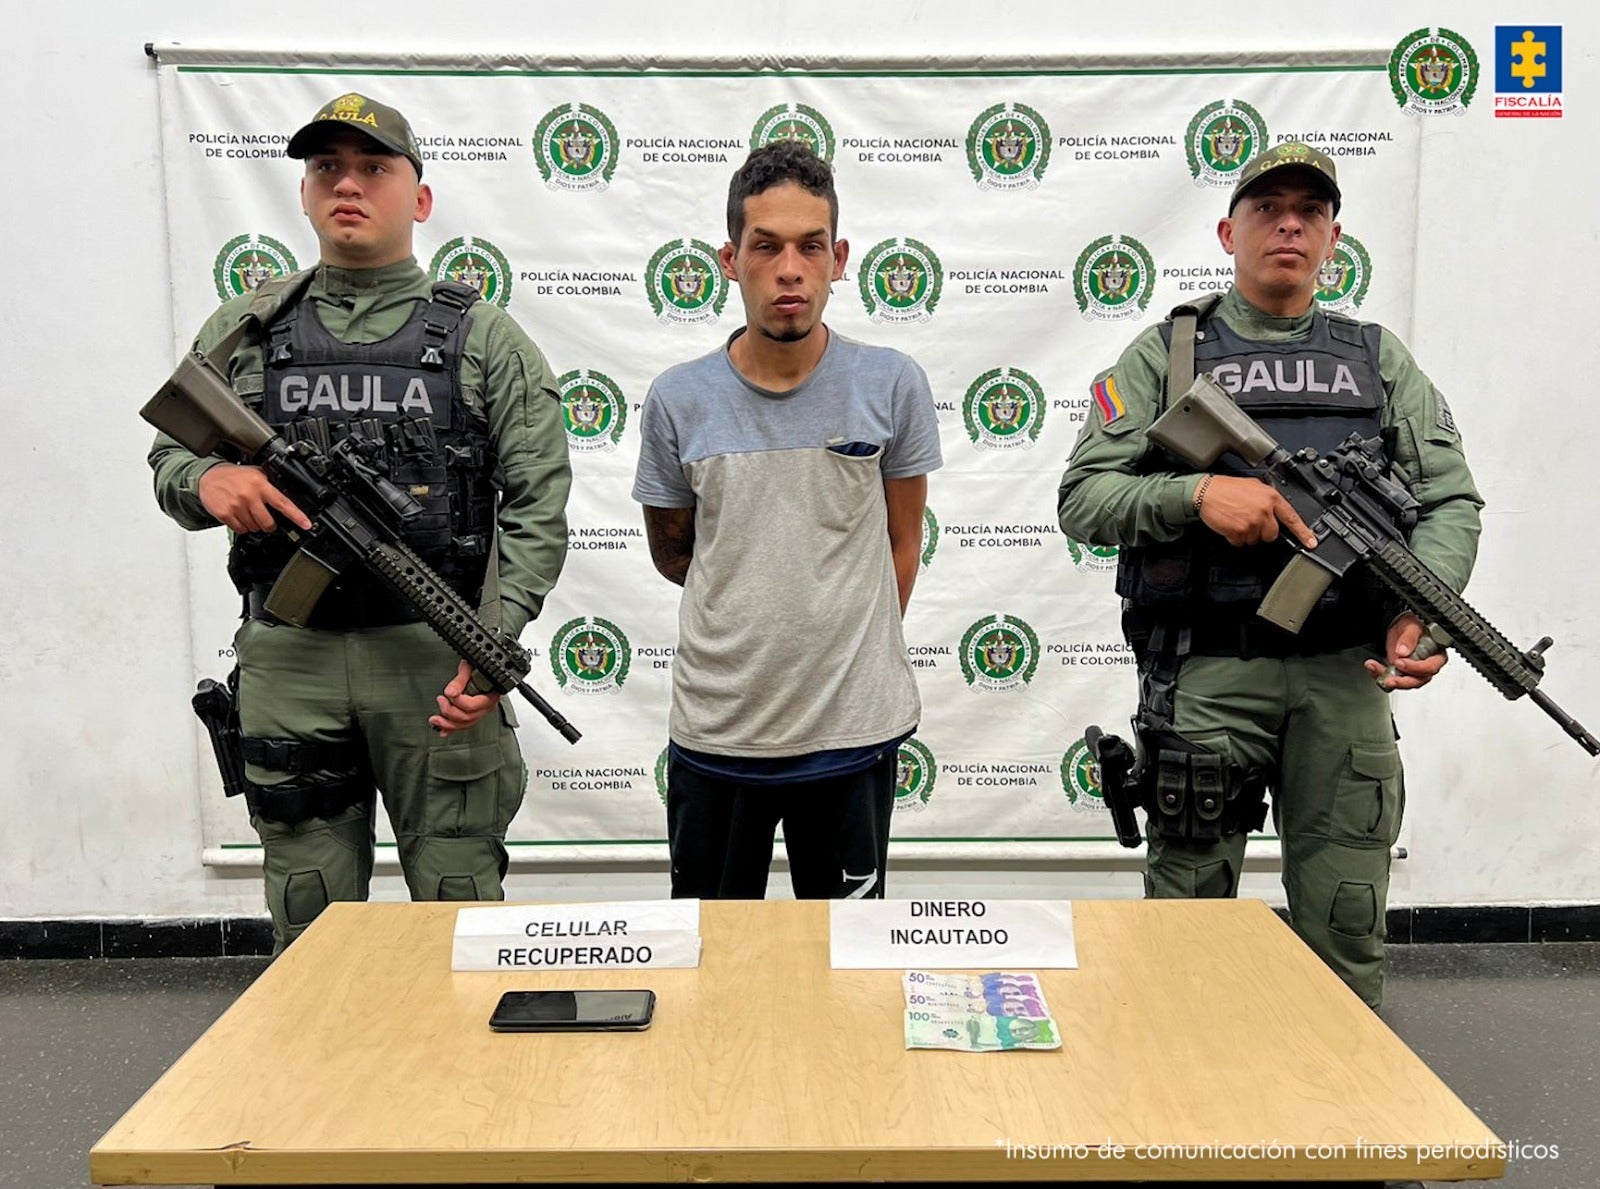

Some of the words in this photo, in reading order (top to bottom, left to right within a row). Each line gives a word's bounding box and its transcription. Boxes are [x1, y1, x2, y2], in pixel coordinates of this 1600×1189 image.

[189, 132, 240, 144] POLICÍA
[242, 135, 290, 144] NACION
[414, 135, 455, 147] OLICÍA
[458, 138, 523, 147] NACIONAL
[1059, 135, 1108, 146] POLICÍA
[1111, 136, 1176, 146] NACIONAL
[1277, 130, 1326, 142] POLICÍA
[1330, 132, 1393, 142] NACIONAL
[626, 136, 676, 148] POLICÍA
[678, 139, 743, 149] NACIONAL
[842, 137, 892, 148] POLICÍA
[894, 138, 959, 148] NACIONAL
[206, 148, 222, 158] DE
[422, 151, 438, 160] DE
[441, 151, 507, 161] COLOMBIA
[643, 153, 659, 162] DE
[662, 153, 728, 163] COLOMBIA
[858, 153, 874, 162] DE
[878, 153, 942, 162] COLOMBIA
[1075, 151, 1091, 160] DE
[1094, 150, 1160, 160] COLOMBIA
[520, 270, 570, 282] POLICÍA
[572, 272, 637, 282] NACIONAL
[949, 268, 998, 280] POLICÍA
[1001, 270, 1065, 280] NACIONAL
[1163, 266, 1212, 278] POLICÍA
[965, 284, 981, 294] DE
[984, 284, 1048, 294] COLOMBIA
[1179, 281, 1195, 290] DE
[1198, 280, 1233, 290] COLO
[537, 286, 552, 295] DE
[556, 286, 622, 296] COLOMBIA
[1212, 360, 1361, 396] GAULA
[280, 374, 434, 414] GAULA
[1053, 399, 1089, 409] POLIC
[1070, 412, 1085, 422] DE
[580, 528, 643, 537] NACIONAL
[945, 524, 992, 534] POLICÍA
[994, 525, 1058, 534] NACIONAL
[960, 538, 976, 548] DE
[978, 538, 1042, 548] COLOMBIA
[638, 646, 676, 656] POLICÍ
[908, 646, 952, 656] CIONAL
[1047, 642, 1093, 653] POLICÍA
[1096, 644, 1132, 652] NACIO
[654, 660, 668, 669] DE
[1062, 656, 1077, 666] DE
[1080, 656, 1134, 665] COLOMBI
[536, 768, 583, 778] POLICÍA
[585, 768, 648, 778] NACIONAL
[942, 762, 988, 774] POLICÍA
[991, 764, 1052, 774] NACIONAL
[552, 782, 567, 790] DE
[569, 780, 632, 790] COLOMBIA
[958, 777, 973, 786] DE
[976, 777, 1037, 786] COLOMBIA
[911, 901, 986, 917] DINERO
[525, 920, 628, 937] CELULAR
[890, 929, 1009, 945] INCAUTADO
[497, 946, 652, 966] RECUPERADO
[909, 972, 925, 983] 50
[910, 995, 926, 1004] 50
[908, 1012, 930, 1021] 100
